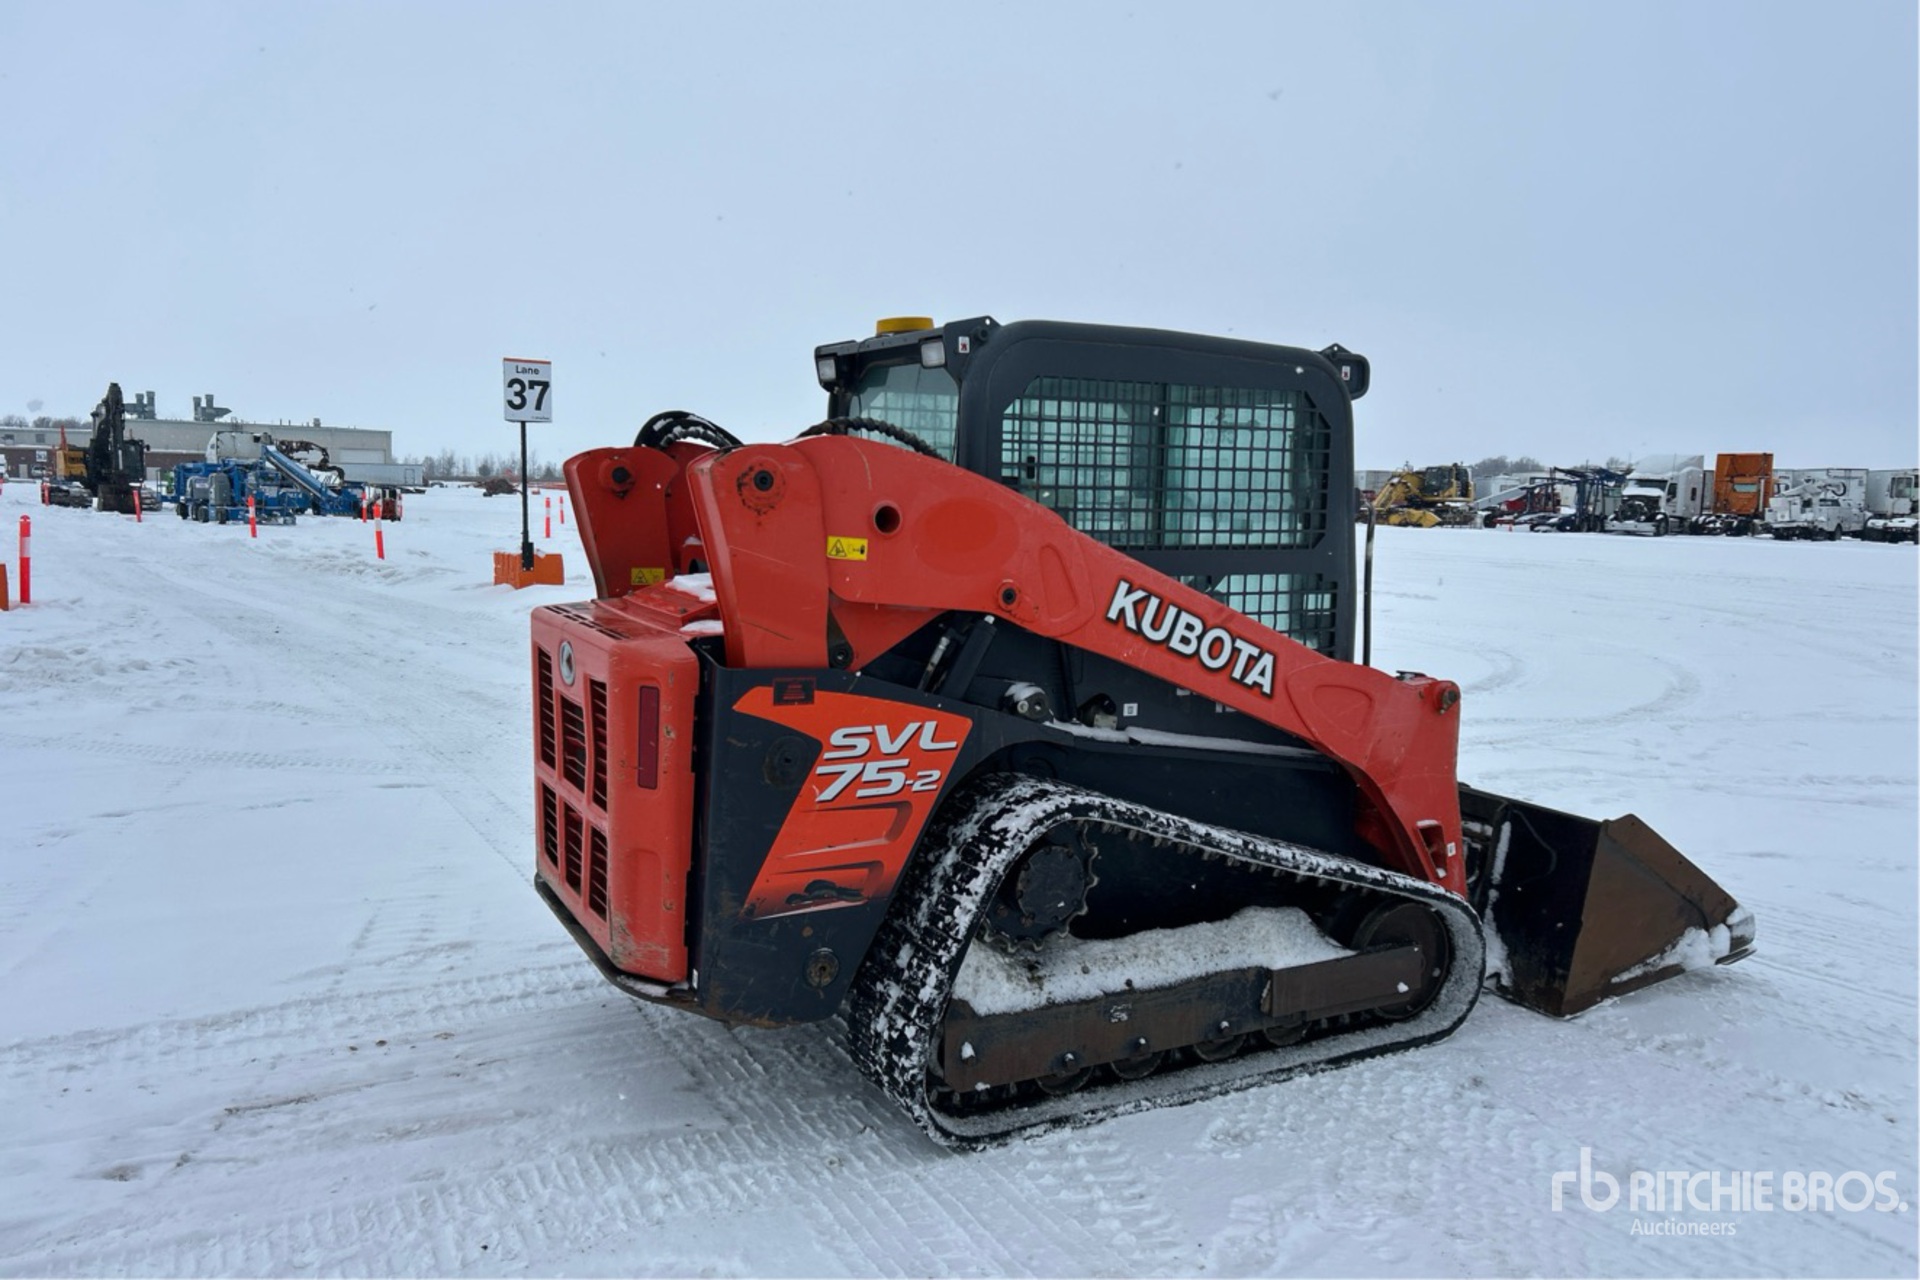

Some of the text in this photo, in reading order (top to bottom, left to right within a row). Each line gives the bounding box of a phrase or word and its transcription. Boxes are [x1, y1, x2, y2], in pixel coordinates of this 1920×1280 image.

[515, 365, 540, 375] Lane
[506, 378, 550, 411] 37
[1106, 580, 1275, 695] KUBOTA
[823, 721, 958, 760] SVL
[815, 758, 942, 802] 75-2
